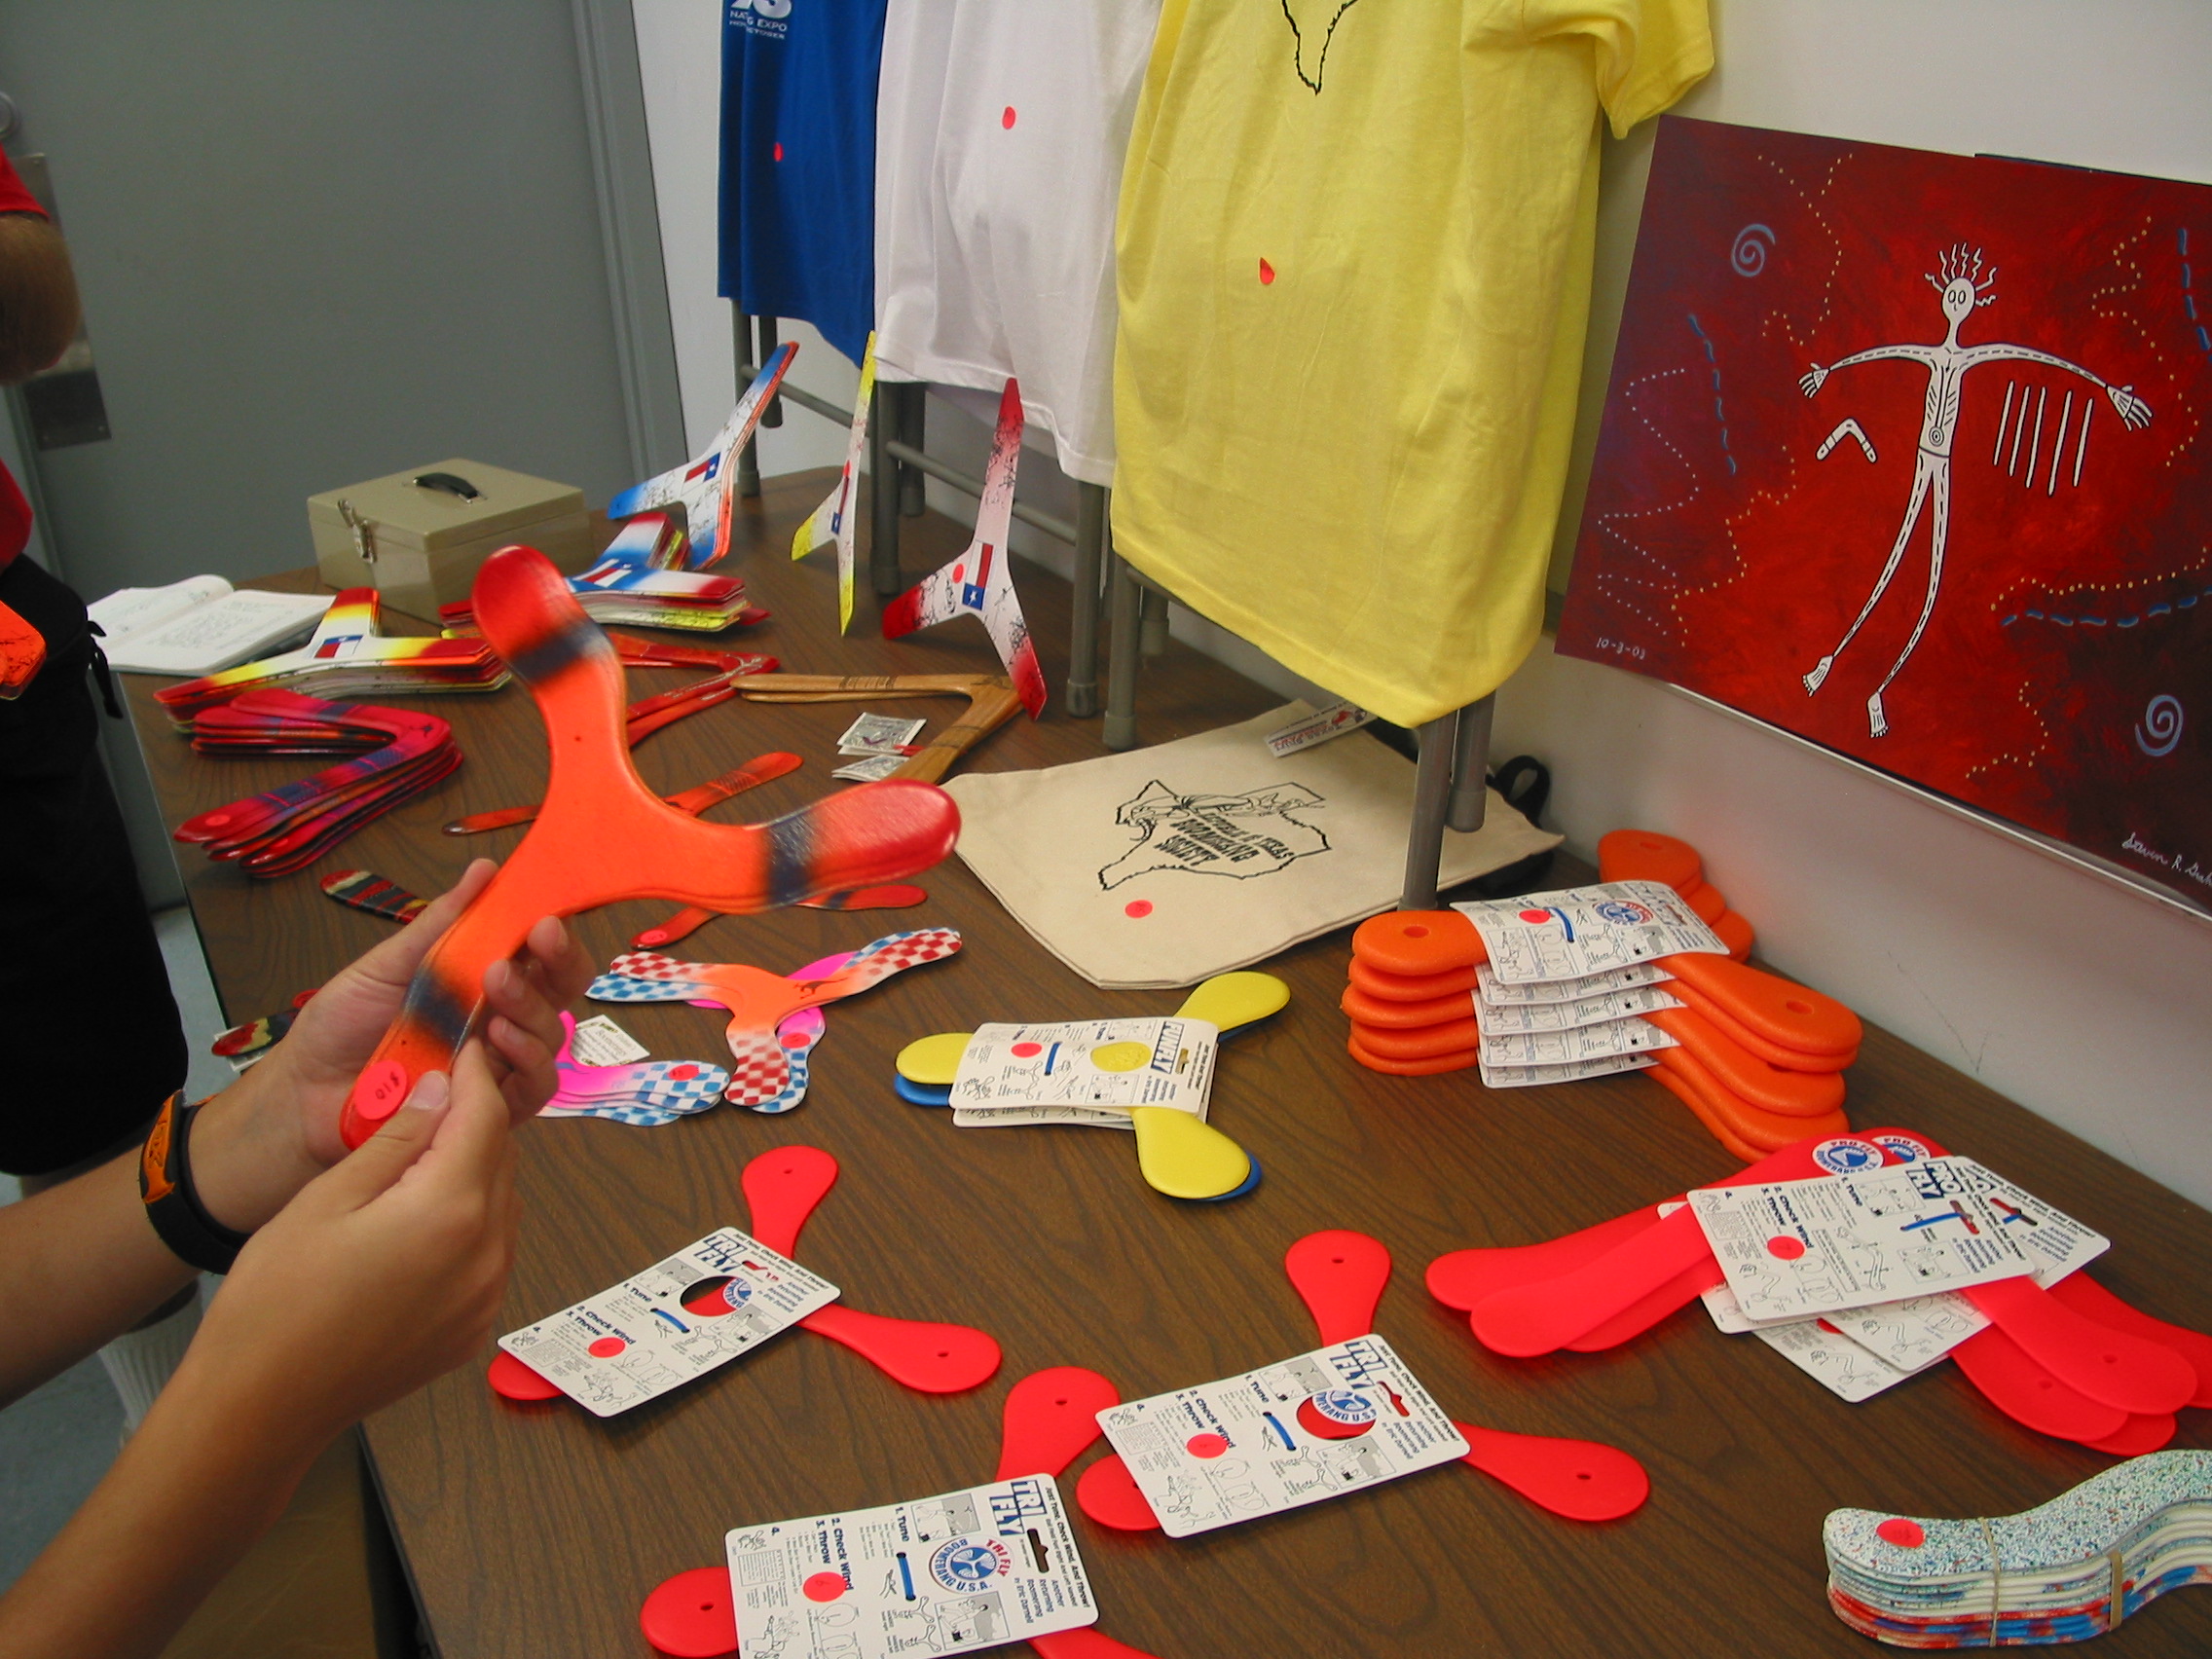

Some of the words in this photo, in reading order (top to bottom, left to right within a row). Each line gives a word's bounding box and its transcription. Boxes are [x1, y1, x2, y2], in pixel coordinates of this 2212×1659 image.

[757, 19, 787, 32] EXPO
[1597, 637, 1646, 660] 10-3-03
[1150, 1020, 1184, 1074] FUNFLY
[1904, 1167, 1944, 1199] FLY
[1922, 1161, 1965, 1195] PRO
[1845, 1185, 1862, 1206] Tune
[1766, 1197, 1787, 1225] Throw
[1778, 1195, 1799, 1223] Check
[1795, 1225, 1814, 1248] Wind
[702, 1232, 748, 1258] TRI
[693, 1246, 741, 1272] FLY
[629, 1287, 650, 1303] Tune
[573, 1315, 602, 1336] Throw
[584, 1309, 611, 1330] Check
[611, 1327, 635, 1345] Wind
[1344, 1338, 1388, 1372] TRI
[1329, 1353, 1375, 1389] FLY
[1250, 1381, 1270, 1403] Tune
[1181, 1401, 1205, 1428] Throw
[1195, 1397, 1219, 1423] Check
[1214, 1424, 1235, 1448] Wind
[1010, 1480, 1047, 1517] TRI
[1045, 1487, 1055, 1501] Just
[815, 1519, 826, 1530] 3.
[830, 1517, 841, 1526] 2.
[988, 1494, 1026, 1536] FLY
[1050, 1502, 1061, 1520] Tune,
[769, 1526, 781, 1535] 4.
[897, 1515, 911, 1542] Tune
[1055, 1522, 1069, 1542] Check
[817, 1530, 832, 1565] Throw
[832, 1527, 849, 1560] Check
[985, 1538, 1008, 1557] TRI
[1062, 1543, 1076, 1563] Wind,
[934, 1538, 968, 1586] BOOMERANG
[996, 1559, 1012, 1577] FLY
[1070, 1565, 1082, 1580] And
[839, 1561, 854, 1591] Wind
[1015, 1585, 1027, 1598] Eric
[1026, 1578, 1043, 1617] Boomerang
[1038, 1578, 1053, 1612] Returning
[1051, 1579, 1065, 1607] Another
[1075, 1581, 1090, 1608] Throw!
[1019, 1599, 1034, 1624] Darnell
